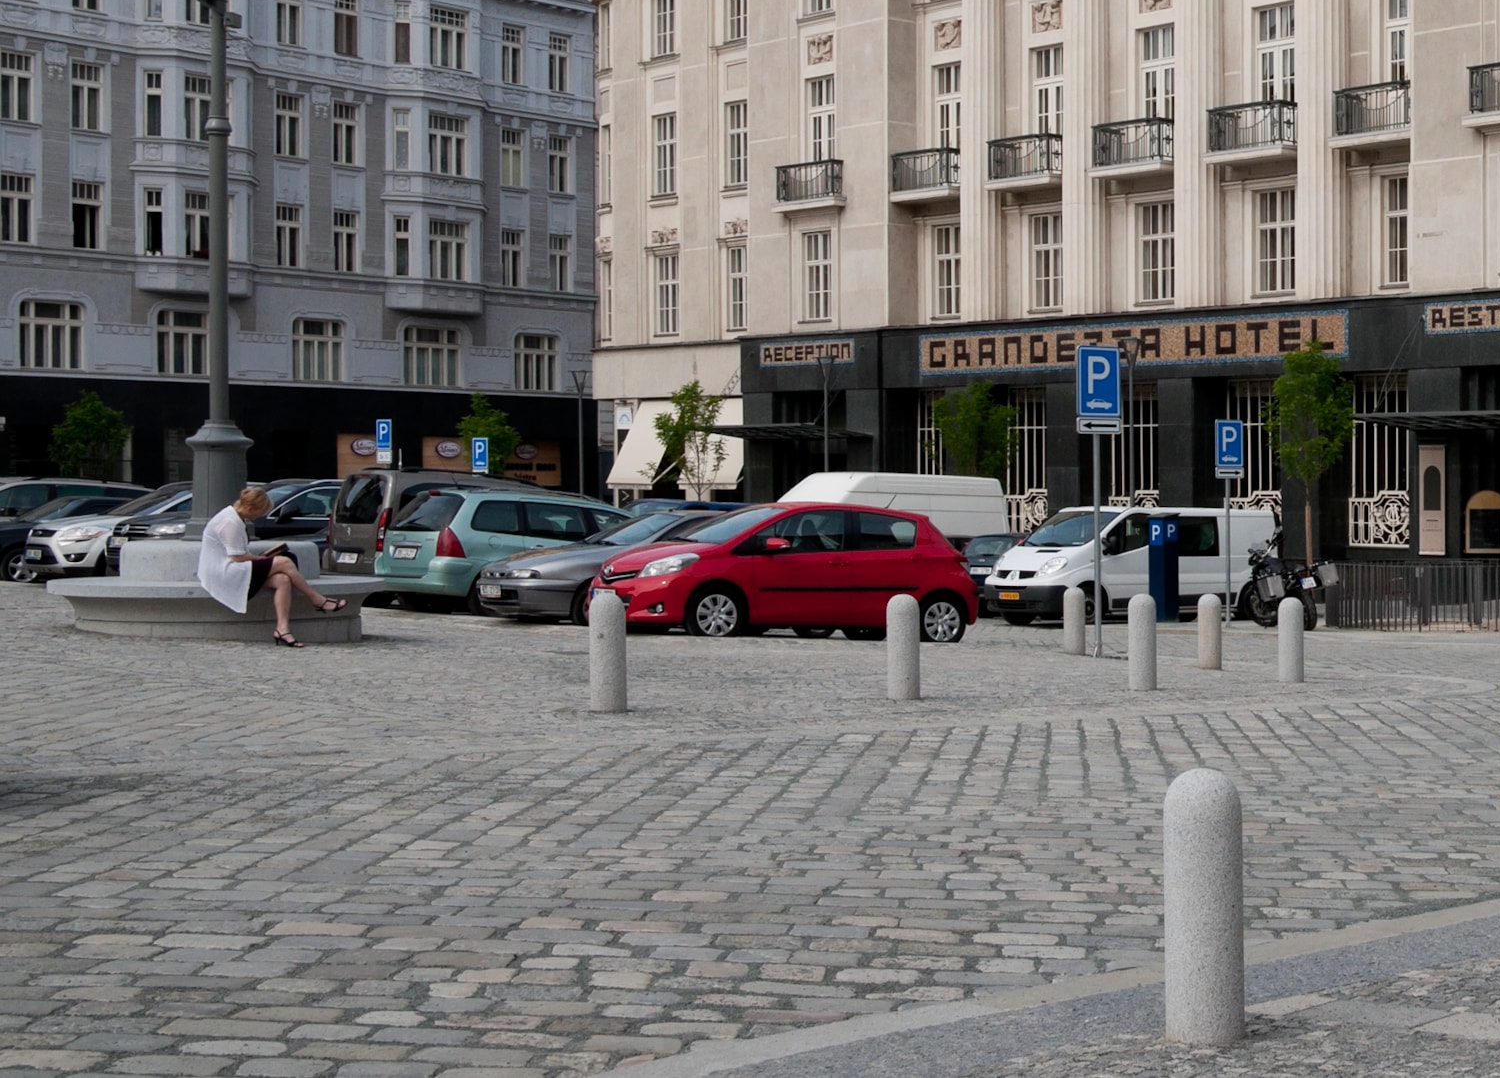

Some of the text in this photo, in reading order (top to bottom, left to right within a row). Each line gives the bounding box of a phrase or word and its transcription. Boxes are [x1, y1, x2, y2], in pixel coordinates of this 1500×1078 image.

[1185, 318, 1335, 356] HOTEL
[763, 342, 851, 362] RECEPTION
[1087, 355, 1111, 395] P
[379, 423, 388, 441] P
[1221, 425, 1237, 452] P
[475, 441, 485, 459] P
[1151, 524, 1161, 542] P
[1167, 523, 1176, 538] P
